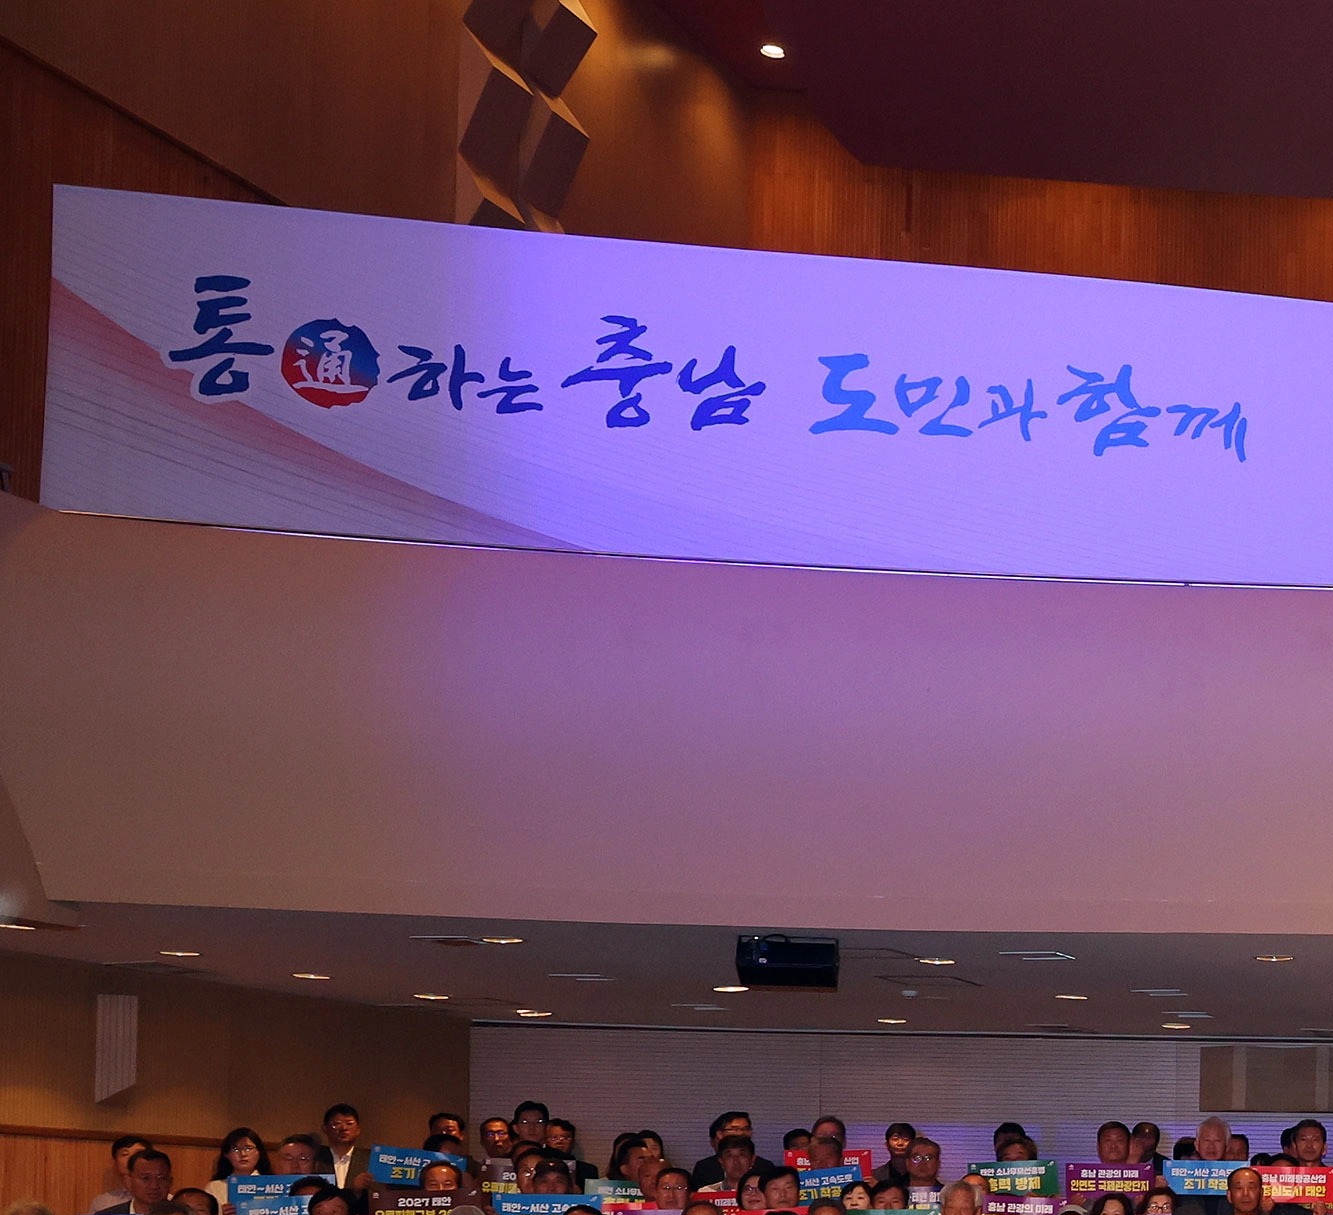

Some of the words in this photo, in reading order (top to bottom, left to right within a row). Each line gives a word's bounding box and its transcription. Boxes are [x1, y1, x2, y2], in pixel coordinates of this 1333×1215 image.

[561, 315, 766, 431] 충남
[809, 355, 1048, 443] 도민과
[1057, 362, 1249, 463] 함께
